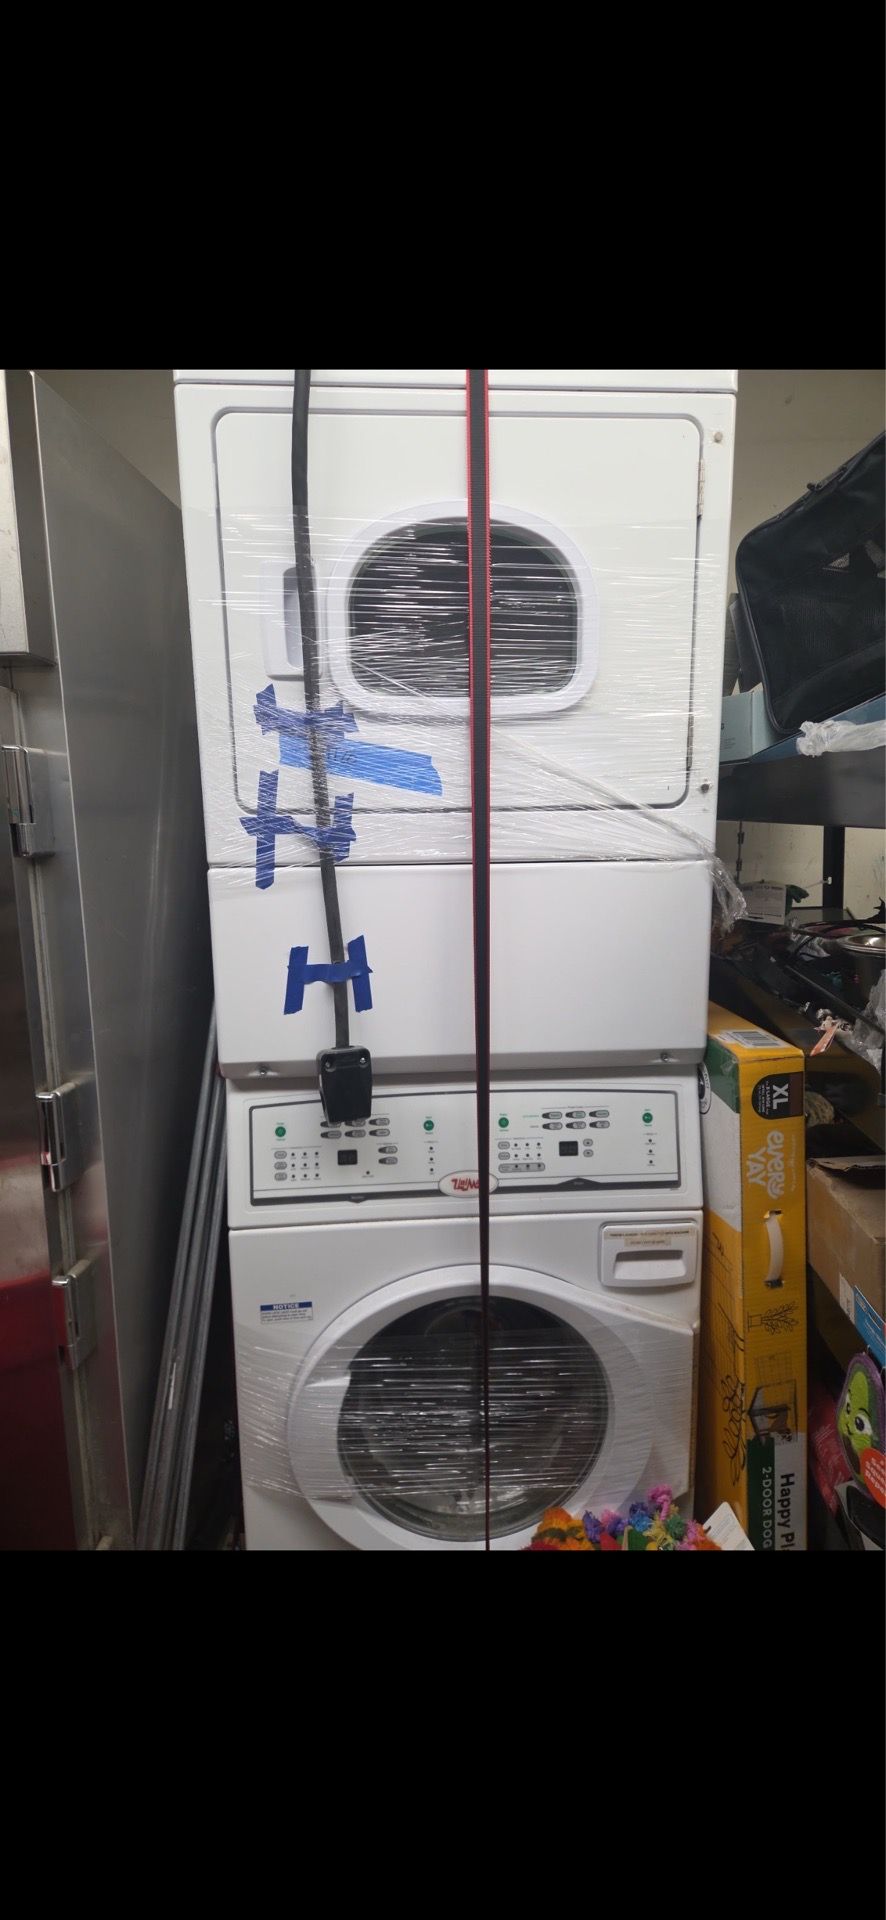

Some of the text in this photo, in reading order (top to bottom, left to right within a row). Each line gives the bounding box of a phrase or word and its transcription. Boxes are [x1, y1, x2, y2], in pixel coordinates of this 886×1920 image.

[772, 1083, 789, 1110] XL
[747, 1147, 767, 1187] YAY
[272, 1302, 299, 1311] NOTICE
[762, 1466, 773, 1550] 2-DOOR DOG
[777, 1473, 795, 1551] Happy Pl
